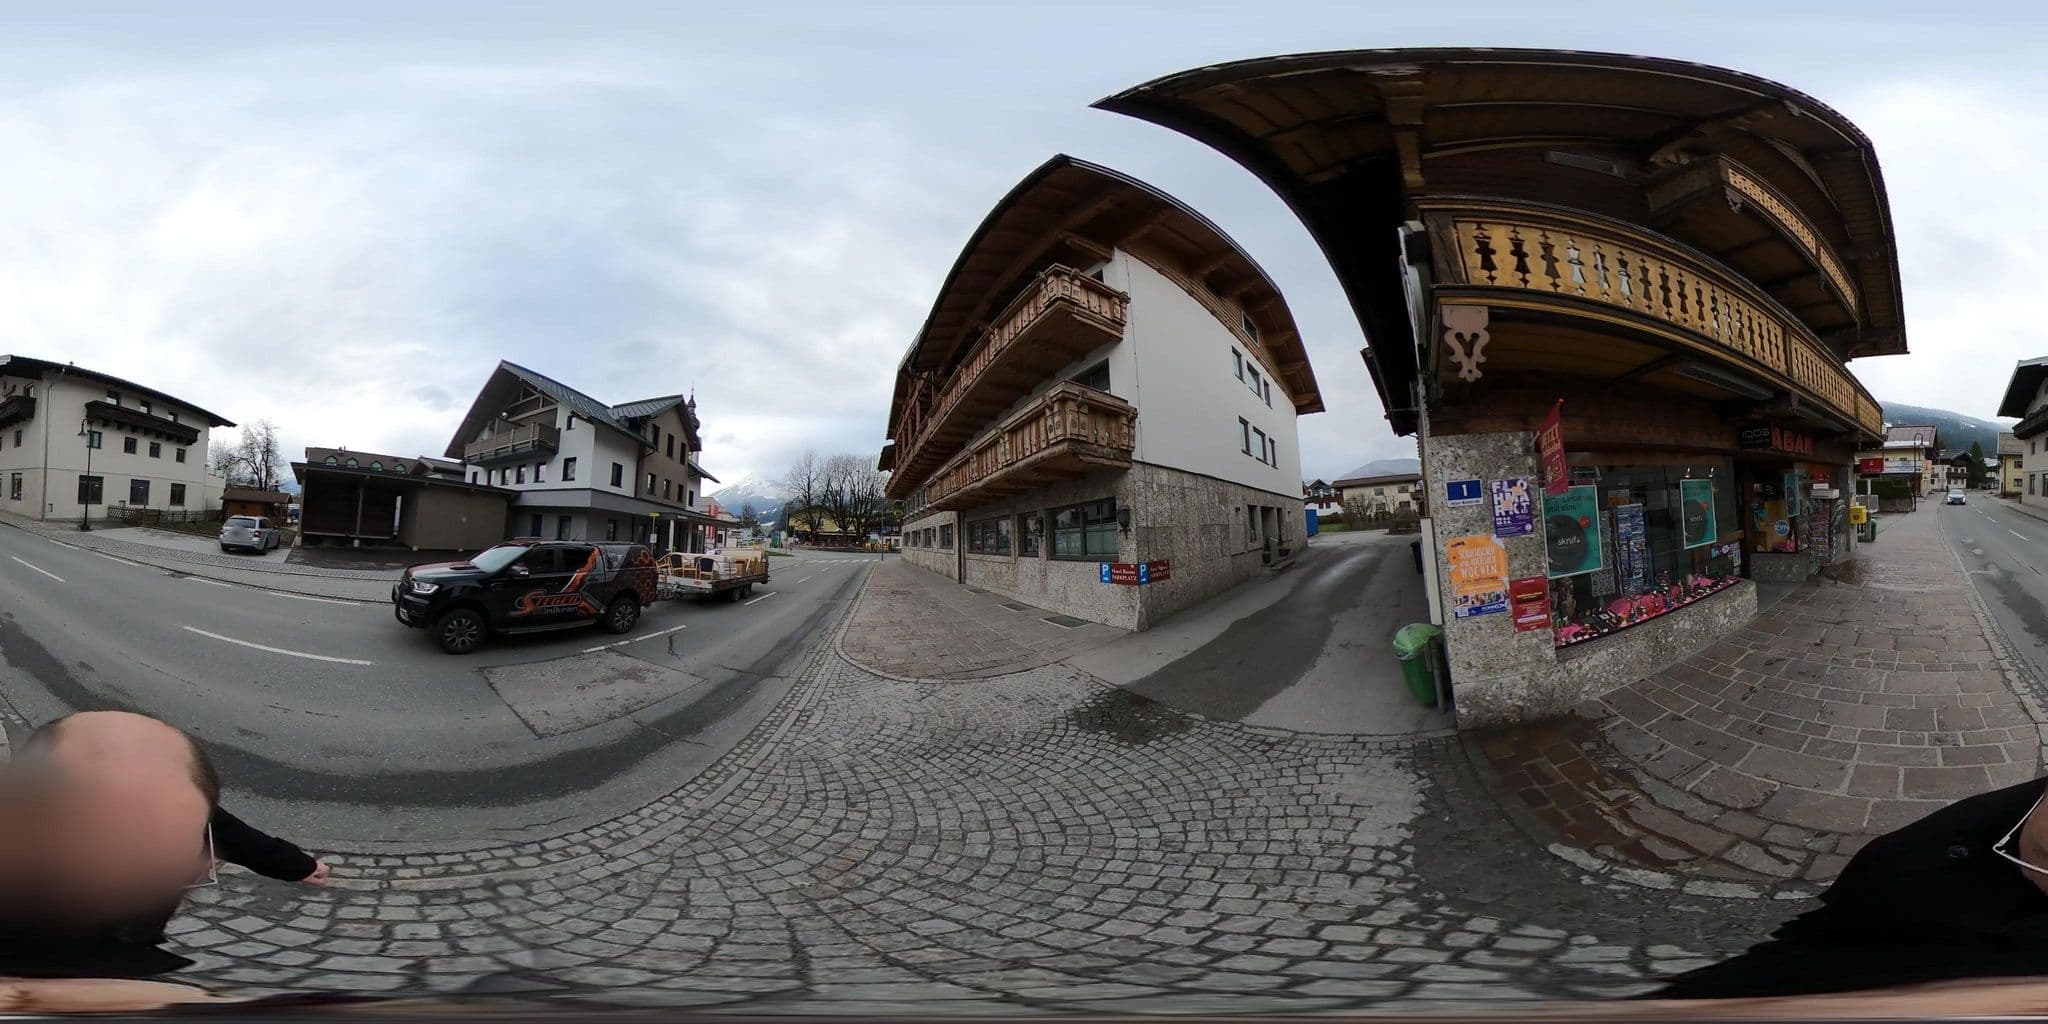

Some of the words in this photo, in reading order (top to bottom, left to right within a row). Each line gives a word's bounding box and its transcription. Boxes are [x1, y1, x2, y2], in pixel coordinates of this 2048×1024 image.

[1742, 428, 1770, 440] IQOS
[1462, 484, 1468, 497] 1
[1102, 564, 1109, 575] P
[1140, 564, 1147, 576] P
[1460, 564, 1497, 578] WOCHEN
[521, 590, 579, 611] STEGER
